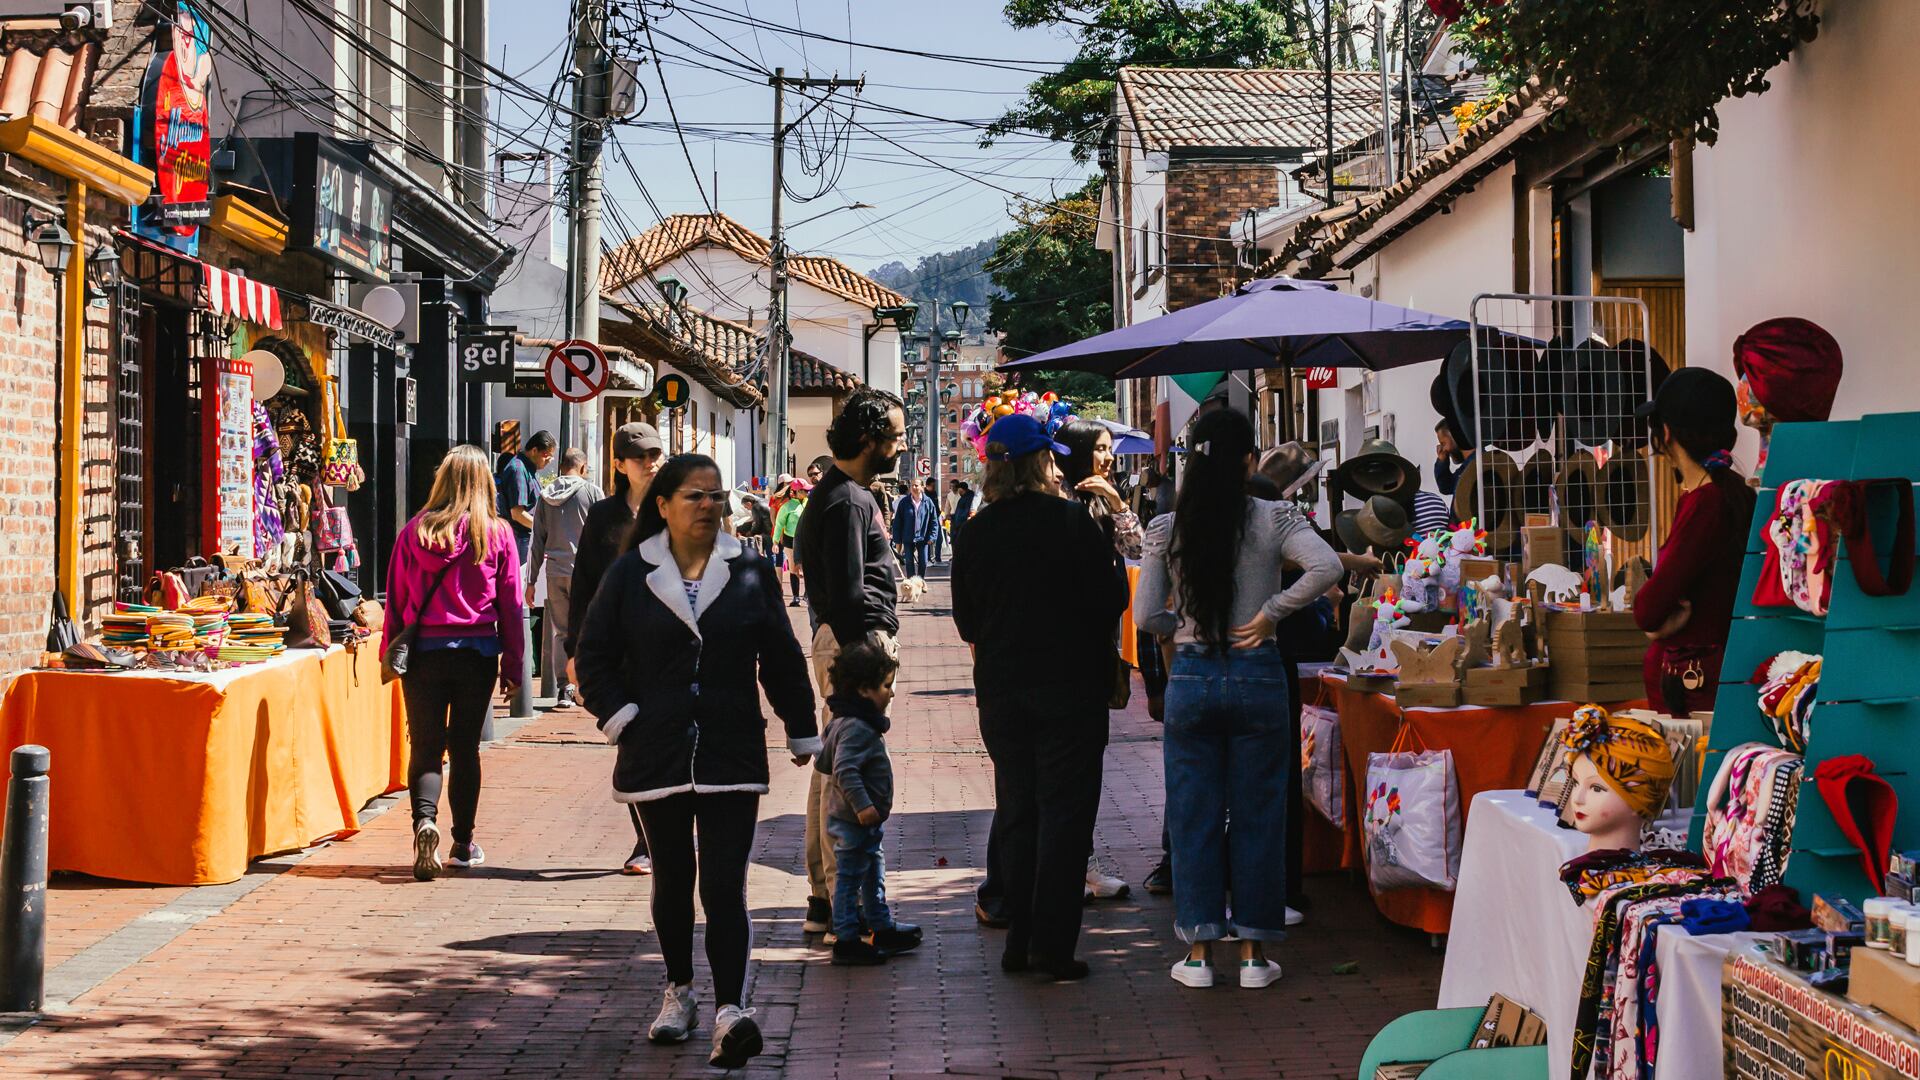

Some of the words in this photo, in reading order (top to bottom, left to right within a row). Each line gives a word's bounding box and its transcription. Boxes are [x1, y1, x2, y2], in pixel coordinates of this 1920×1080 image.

[464, 339, 510, 371] gef
[565, 349, 596, 392] P
[1309, 366, 1333, 385] illy
[1732, 954, 1784, 1003] Propiedades
[1784, 981, 1837, 1033] medicinales
[1836, 1008, 1854, 1043] del
[1852, 1021, 1898, 1068] cannabis
[1732, 984, 1762, 1021] Reduce
[1769, 1005, 1790, 1038] dolor
[1733, 1014, 1769, 1057] Relajante
[1769, 1037, 1806, 1078] muscular
[1735, 1043, 1761, 1080] Induce
